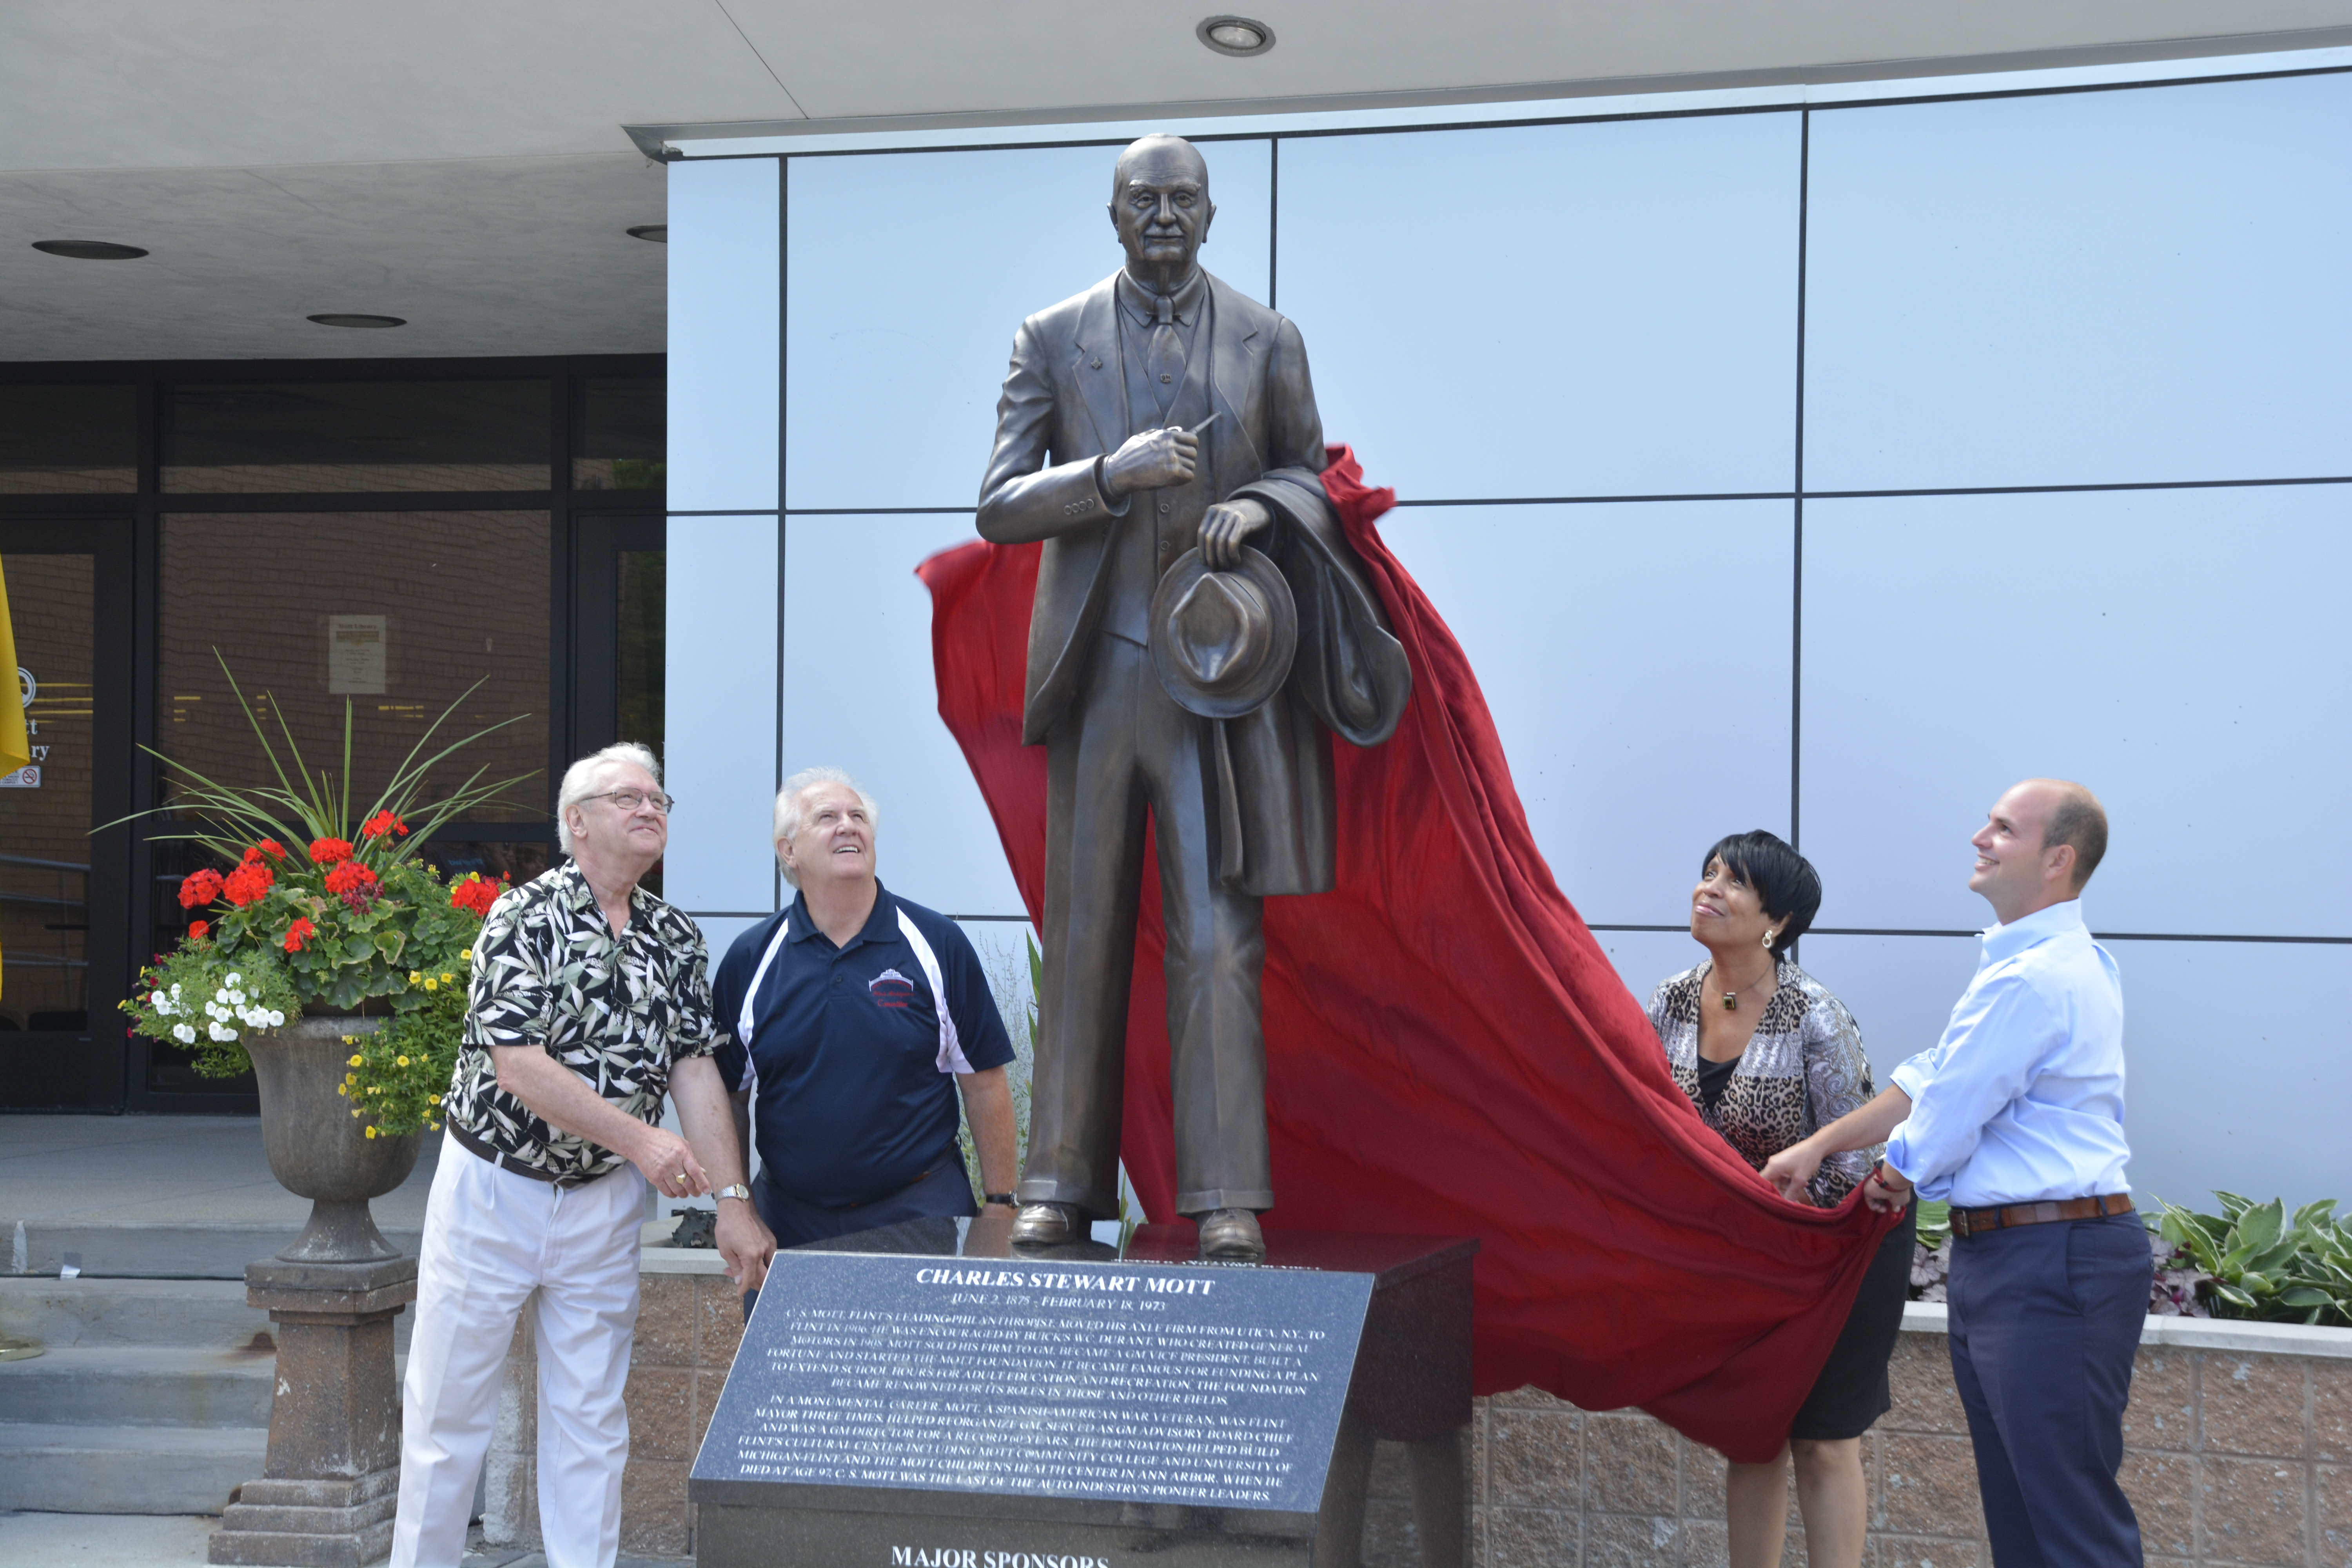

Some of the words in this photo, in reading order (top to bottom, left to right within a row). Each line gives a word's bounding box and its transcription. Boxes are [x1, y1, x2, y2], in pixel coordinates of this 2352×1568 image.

[916, 1269, 1024, 1286] CHARLES
[1028, 1274, 1140, 1291] STEWART
[1145, 1278, 1215, 1294] MOTT
[952, 1293, 987, 1303] JUNE
[1006, 1295, 1030, 1305] 1875
[1042, 1297, 1115, 1308] FEBRUARY
[1140, 1301, 1165, 1310] 1973
[791, 1322, 823, 1331] FLINT
[828, 1323, 840, 1332] IN
[891, 1326, 916, 1335] WAS
[919, 1328, 1003, 1338] ENCOURAGED
[1024, 1332, 1071, 1341] BUICK'S
[1157, 1338, 1187, 1346] WHO
[1189, 1340, 1249, 1349] CREATED
[1250, 1343, 1309, 1352] GENERAL
[849, 1311, 892, 1320] FLINT'S
[896, 1314, 949, 1323] LEADING
[1059, 1320, 1103, 1329] MOVED
[1106, 1322, 1126, 1330] HIS
[1128, 1323, 1161, 1332] AXLE
[1165, 1325, 1196, 1333] FIRM
[1200, 1326, 1234, 1335] FROM
[1308, 1331, 1325, 1339] TO
[768, 1349, 823, 1358] FORTUNE
[856, 1352, 910, 1361] STARTED
[913, 1354, 936, 1363] THE
[940, 1356, 974, 1365] MOTT
[1062, 1361, 1073, 1369] IT
[1076, 1362, 1127, 1372] BECAME
[1131, 1364, 1181, 1374] FAMOUS
[1185, 1367, 1208, 1376] FOR
[1212, 1368, 1270, 1379] FUNDING
[1285, 1372, 1319, 1381] PLAN
[791, 1336, 841, 1345] MOTORS
[843, 1338, 855, 1346] IN
[887, 1340, 920, 1348] MOTT
[924, 1341, 956, 1350] SOLD
[981, 1344, 1011, 1352] FIRM
[1060, 1347, 1109, 1356] BECAME
[1149, 1351, 1178, 1359] VICE
[1254, 1356, 1290, 1365] BUILT
[771, 1362, 787, 1370] TO
[789, 1363, 838, 1372] EXTEND
[841, 1366, 889, 1374] SCHOOL
[892, 1367, 933, 1376] HOURS
[936, 1370, 959, 1378] FOR
[963, 1370, 1005, 1380] ADULT
[1007, 1372, 1076, 1383] EDUCATION
[1081, 1376, 1109, 1384] AND
[1198, 1381, 1221, 1390] THE
[1224, 1383, 1306, 1394] FOUNDATION
[832, 1379, 882, 1388] BECAME
[885, 1381, 956, 1391] RENOWNED
[958, 1384, 982, 1393] FOR
[985, 1385, 1004, 1394] ITS
[1007, 1386, 1045, 1395] ROLES
[1048, 1388, 1060, 1397] IN
[1065, 1389, 1105, 1398] THOSE
[1108, 1391, 1136, 1399] AND
[1137, 1393, 1181, 1403] OTHER
[755, 1408, 798, 1418] MAYOR
[802, 1410, 842, 1420] THREE
[887, 1414, 935, 1424] HELPED
[937, 1417, 1017, 1428] REORGANIZE
[1046, 1422, 1095, 1432] SERVED
[1098, 1425, 1113, 1433] AS
[1116, 1426, 1136, 1434] GM
[1140, 1427, 1203, 1438] ADVISORY
[1207, 1430, 1253, 1440] BOARD
[1255, 1433, 1293, 1443] CHIEF
[771, 1395, 784, 1403] IN
[798, 1397, 885, 1407] MONUMENTAL
[996, 1406, 1117, 1418] SPANISH-AMERICAN
[1121, 1412, 1149, 1421] WAR
[1219, 1416, 1245, 1426] WAS
[1249, 1418, 1286, 1428] FLINT
[738, 1436, 783, 1445] FLINT'S
[785, 1438, 850, 1449] CULTURAL
[853, 1442, 903, 1452] CENTER
[906, 1444, 976, 1454] INCLUDING
[978, 1447, 1013, 1457] MOTT
[1016, 1450, 1098, 1461] COMMUNITY
[1101, 1454, 1158, 1464] COLLEGE
[1162, 1457, 1191, 1466] AND
[1194, 1459, 1272, 1470] UNIVERSITY
[1276, 1463, 1292, 1472] OF
[761, 1423, 788, 1432] AND
[789, 1424, 816, 1433] WAS
[829, 1426, 850, 1435] GM
[852, 1428, 914, 1437] DIRECTOR
[916, 1430, 940, 1439] FOR
[955, 1432, 1007, 1442] RECORD
[1073, 1437, 1099, 1447] THE
[1102, 1439, 1183, 1450] FOUNDATION
[1187, 1444, 1237, 1454] HELPED
[1240, 1446, 1279, 1456] BUILD
[738, 1451, 839, 1462] MICHIGAN-FLINT
[842, 1455, 870, 1464] AND
[874, 1457, 898, 1466] THE
[900, 1458, 935, 1468] MOTT
[938, 1460, 1012, 1471] CHILDREN'S
[1014, 1464, 1065, 1474] HEALTH
[1067, 1466, 1118, 1477] CENTER
[1121, 1469, 1135, 1479] IN
[1138, 1470, 1167, 1480] ANN
[1222, 1475, 1263, 1485] WHEN
[1266, 1477, 1283, 1486] HE
[740, 1465, 771, 1474] DIED
[773, 1466, 789, 1475] AT
[792, 1468, 815, 1476] AGE
[861, 1470, 897, 1480] MOTT
[899, 1472, 926, 1482] WAS
[929, 1474, 953, 1483] THE
[956, 1475, 987, 1485] LAST
[990, 1477, 1006, 1486] OF
[1010, 1478, 1035, 1487] THE
[1038, 1479, 1073, 1489] AUTO
[1076, 1481, 1150, 1493] INDUSTRY'S
[1153, 1486, 1207, 1497] PIONEER
[892, 1546, 977, 1568] MAJOR
[984, 1551, 1109, 1568] SPONSORS
